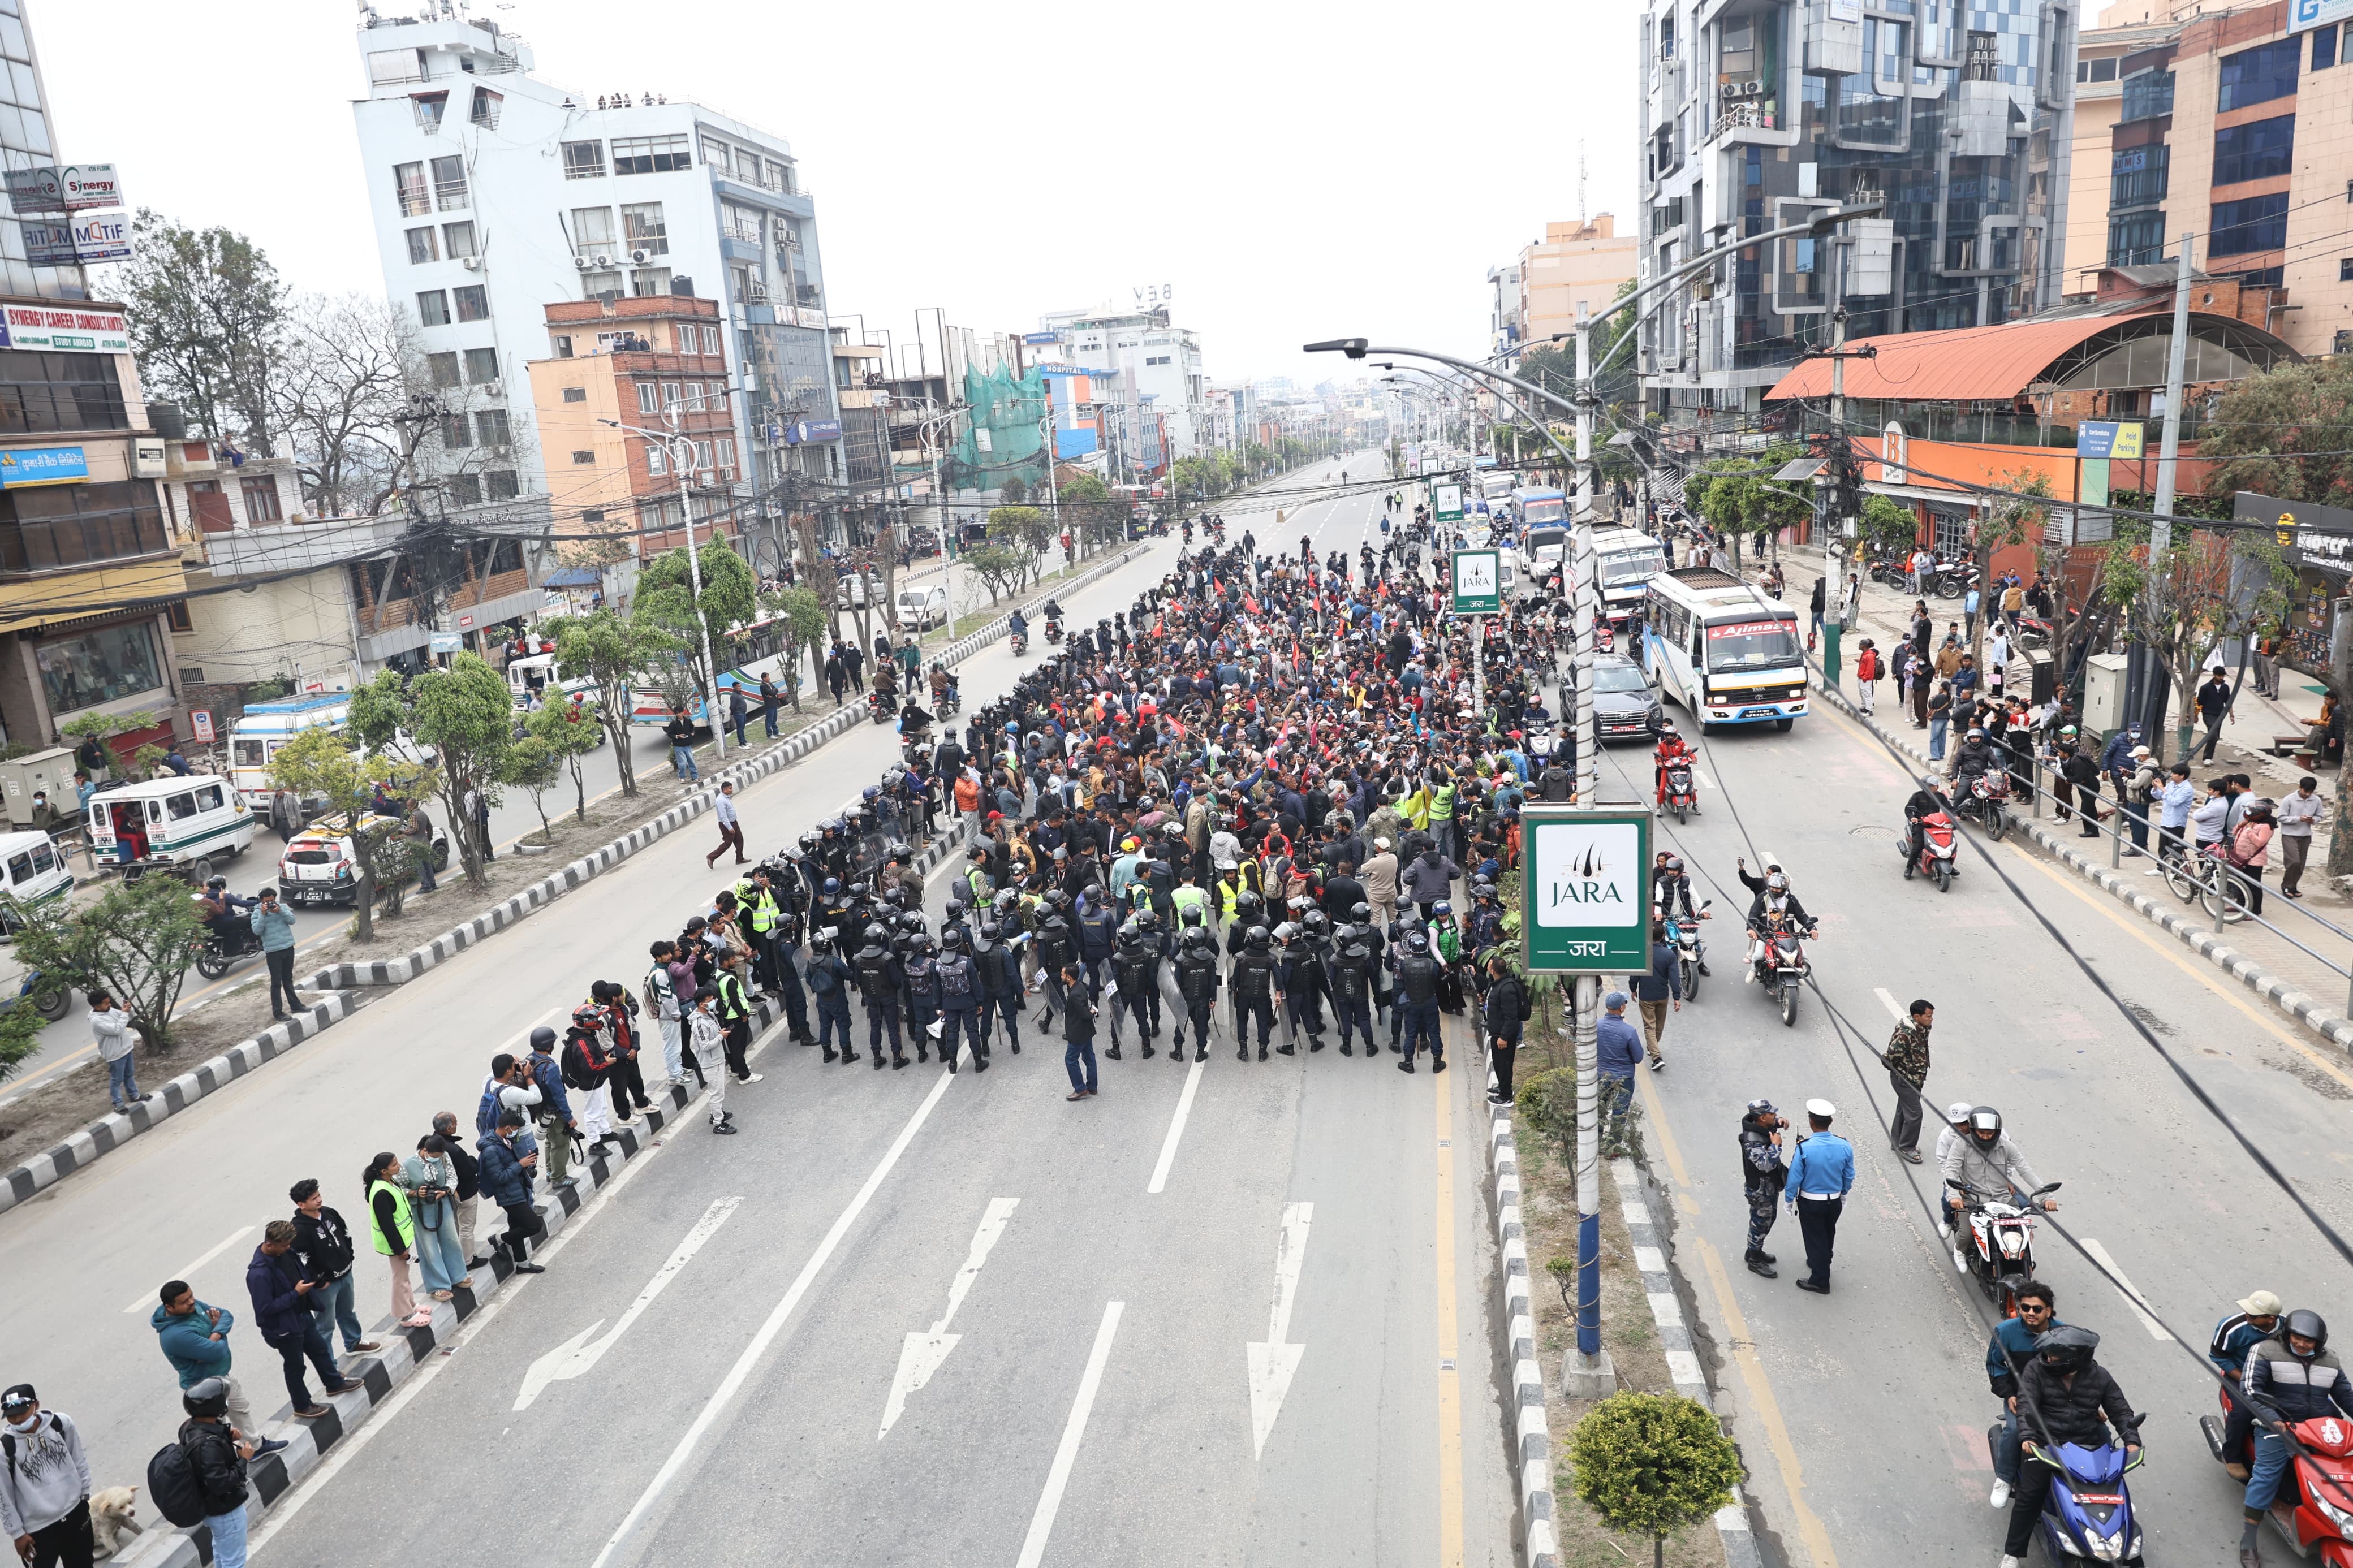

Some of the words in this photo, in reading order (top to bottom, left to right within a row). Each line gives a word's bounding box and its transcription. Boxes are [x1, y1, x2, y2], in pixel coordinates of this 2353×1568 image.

[68, 180, 114, 192] Synergy
[8, 309, 44, 327] SYNERGY
[46, 312, 75, 329] CAREER
[76, 314, 124, 332] CONSULTANTS
[55, 338, 71, 347] STUDY
[72, 339, 93, 348] ABROAD
[1046, 365, 1082, 374] HOSPITAL
[1887, 433, 1900, 463] B
[2117, 444, 2136, 454] Parking
[22, 455, 46, 471] कुमारी
[58, 452, 84, 466] लिमिटेड
[1441, 499, 1458, 508] JARA
[1463, 576, 1490, 588] JARA
[1723, 621, 1783, 636] Ajimaa
[1550, 882, 1624, 908] JARA
[1567, 941, 1606, 956] जरा
